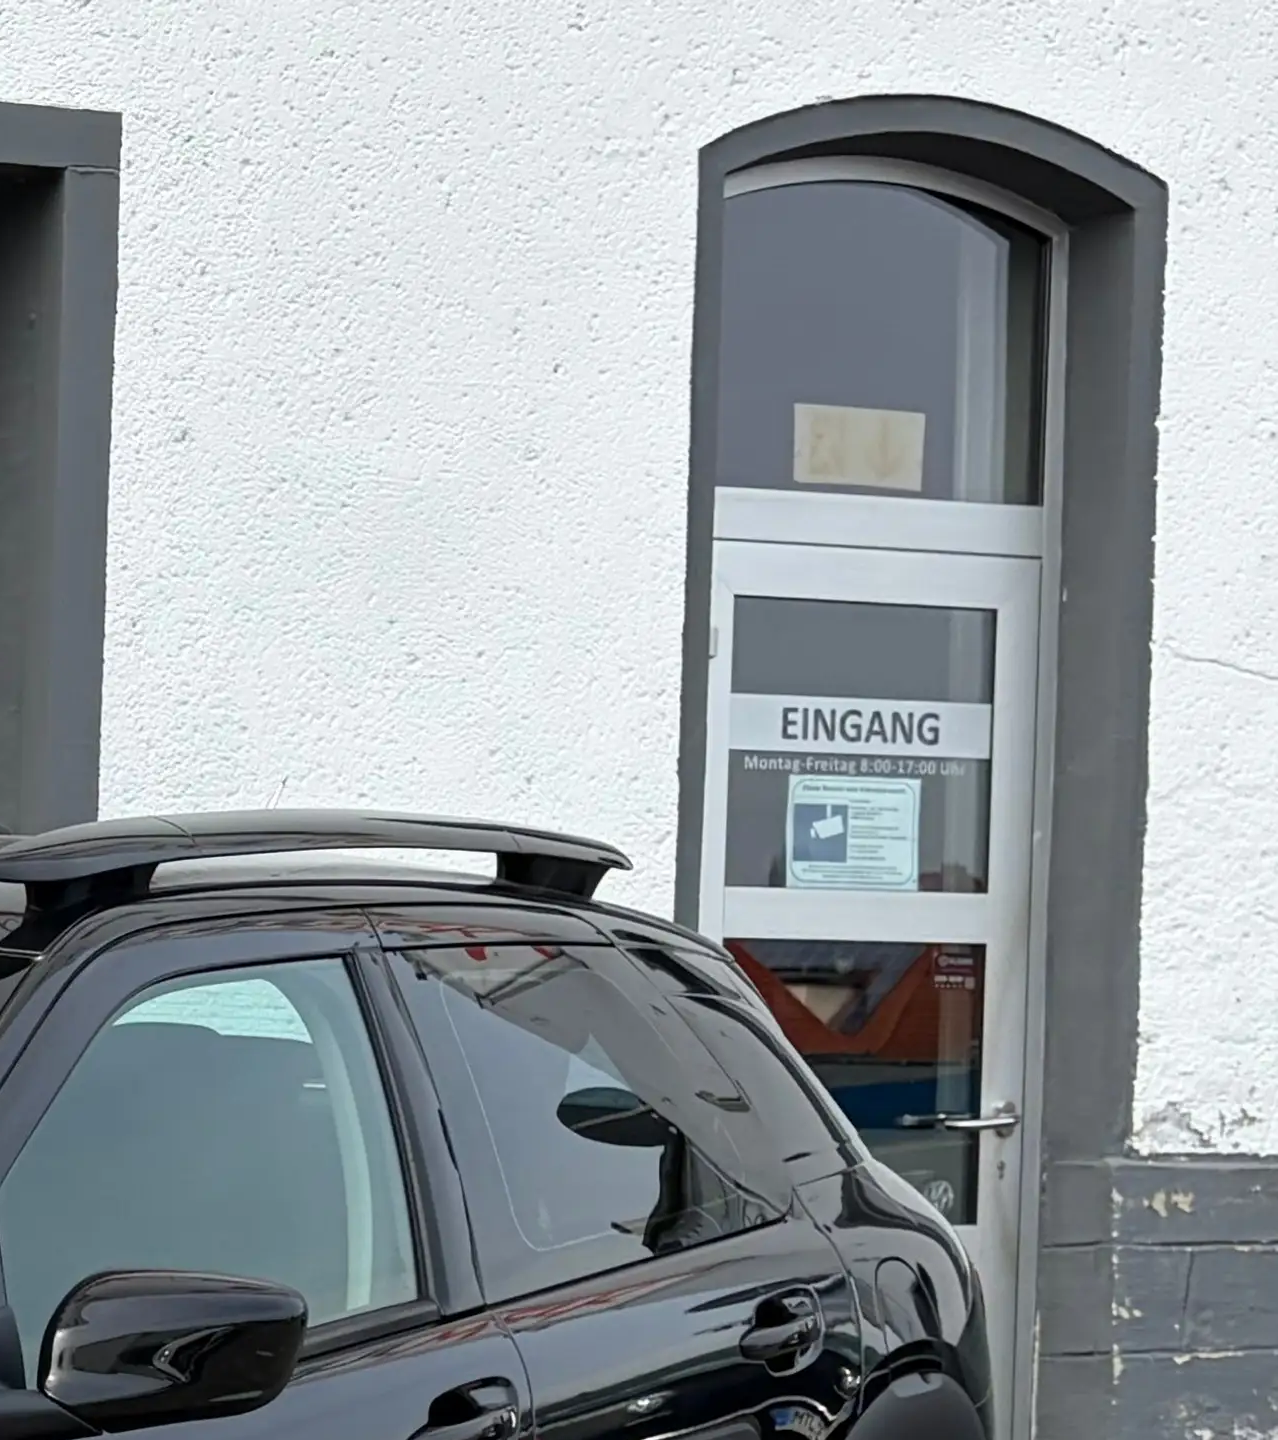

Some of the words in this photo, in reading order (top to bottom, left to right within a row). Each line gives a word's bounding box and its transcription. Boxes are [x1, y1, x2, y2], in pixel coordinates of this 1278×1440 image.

[781, 706, 940, 746] EINGANG
[744, 755, 857, 775] Montag-Freitag
[859, 758, 937, 776] 8:00-17:00
